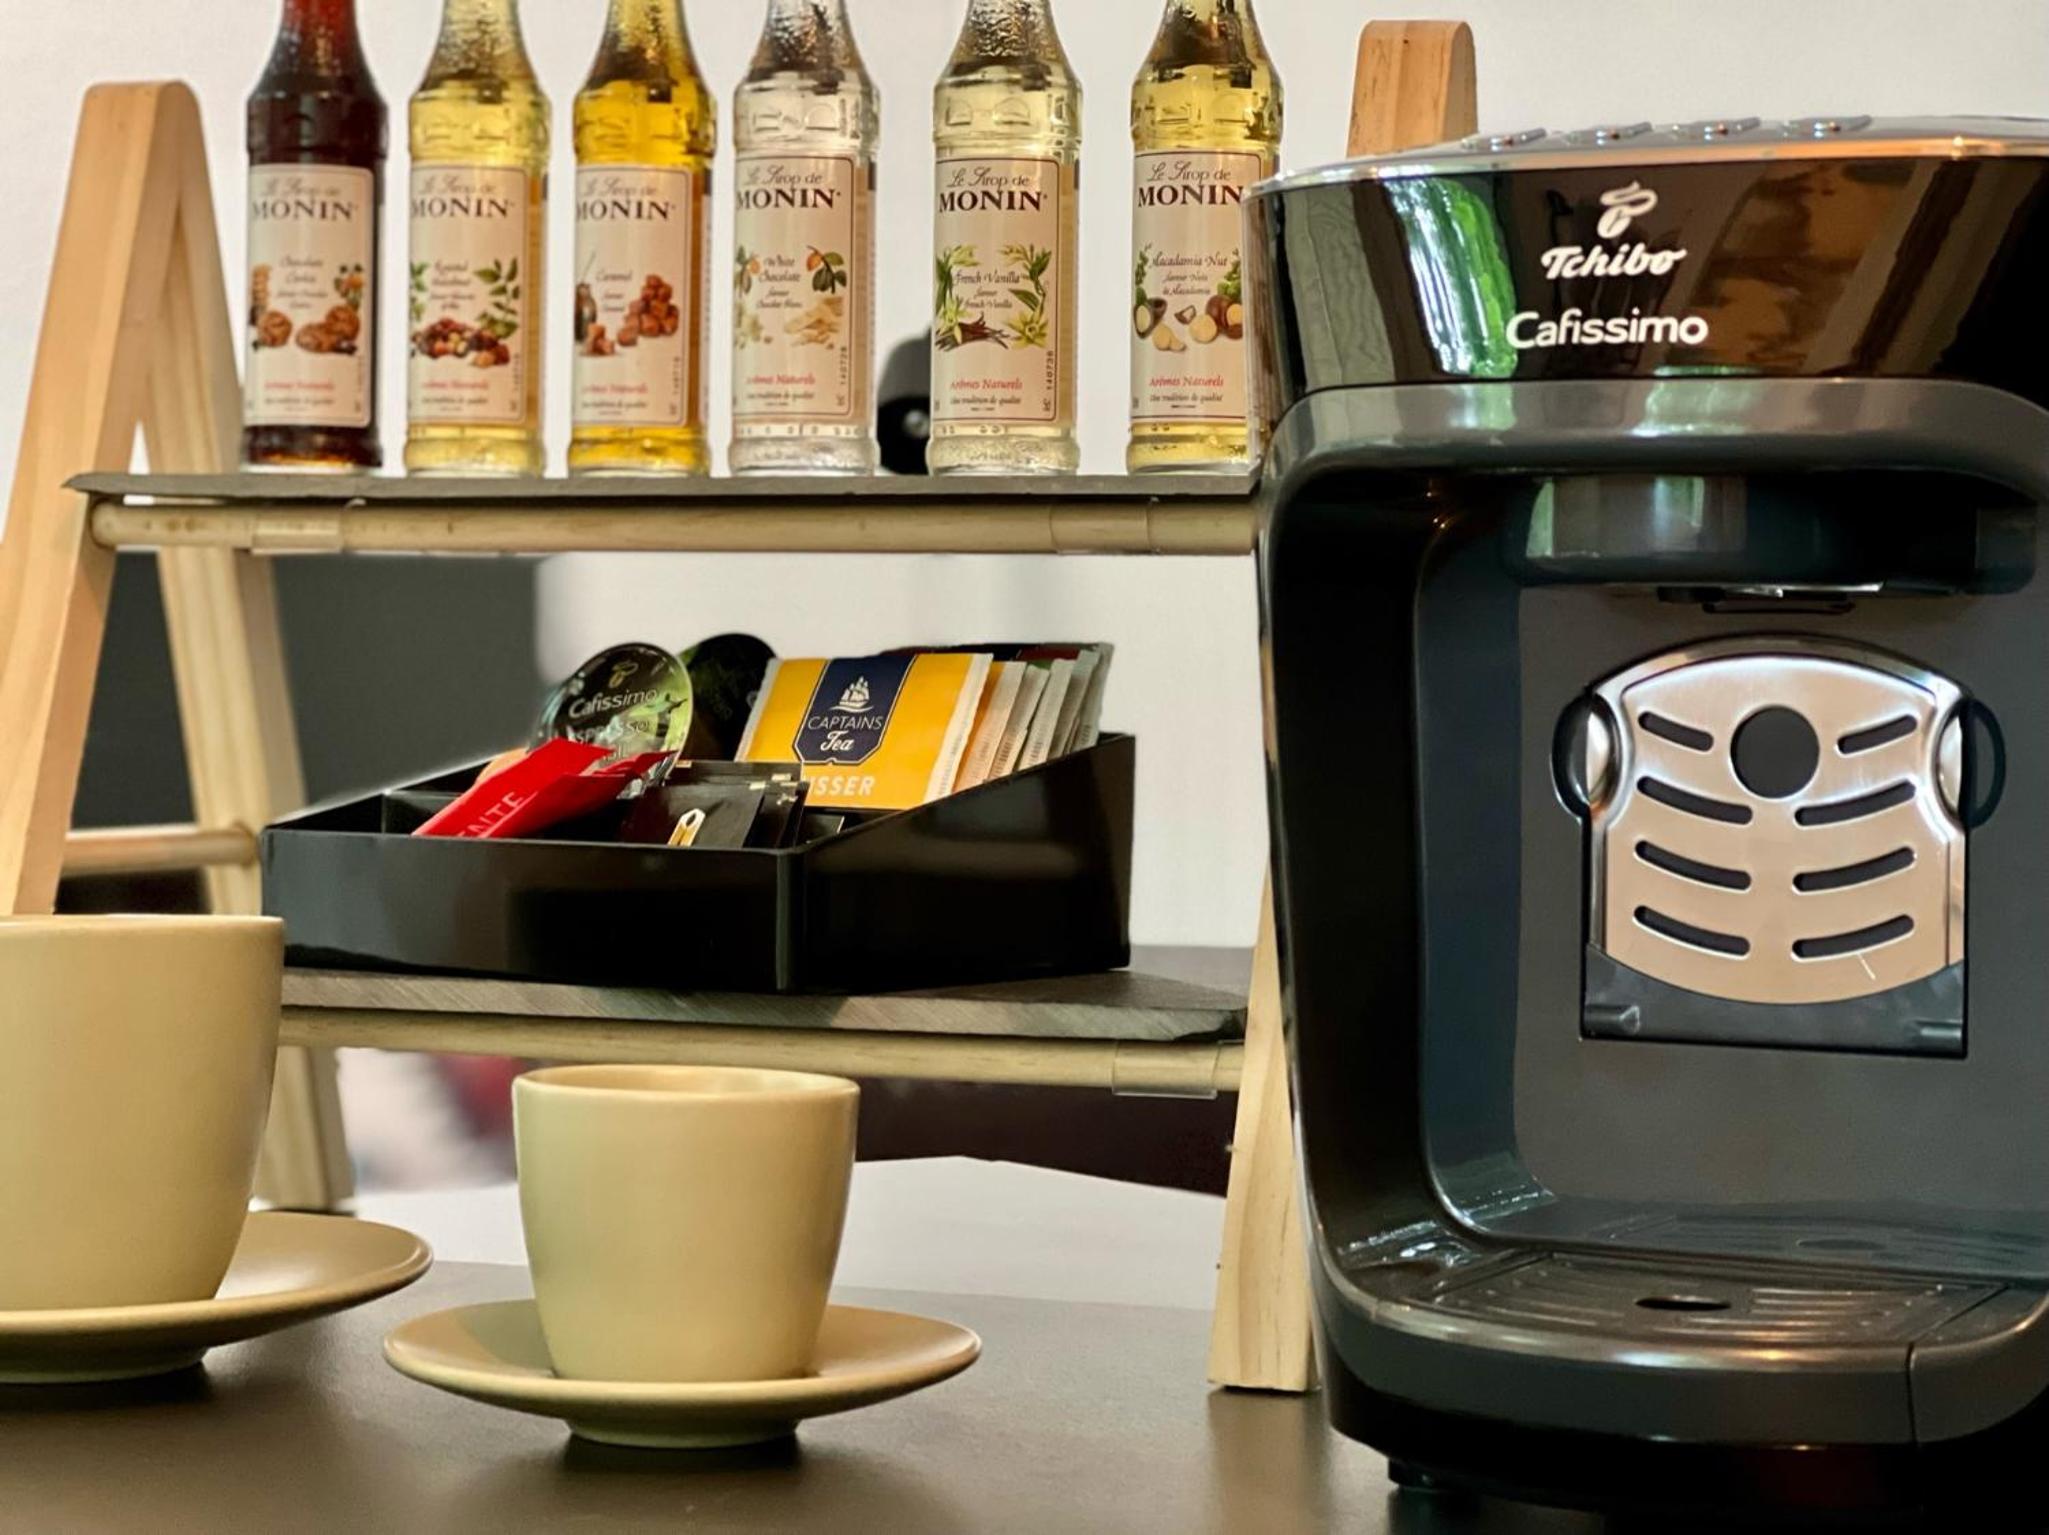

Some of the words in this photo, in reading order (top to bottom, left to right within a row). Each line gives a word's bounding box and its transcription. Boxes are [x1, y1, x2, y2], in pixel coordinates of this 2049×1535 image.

[805, 173, 822, 184] de
[968, 166, 1008, 191] Sirop
[1012, 174, 1029, 186] de
[1168, 161, 1210, 184] Sirop
[1214, 169, 1231, 181] de
[939, 189, 1042, 213] MONIN
[1138, 184, 1243, 208] MONIN
[1541, 242, 1687, 279] Tchibo
[1506, 306, 1709, 349] Cafissimo
[568, 689, 657, 719] Cafissimo
[807, 715, 884, 730] CAPTAINS
[820, 730, 855, 751] Tea
